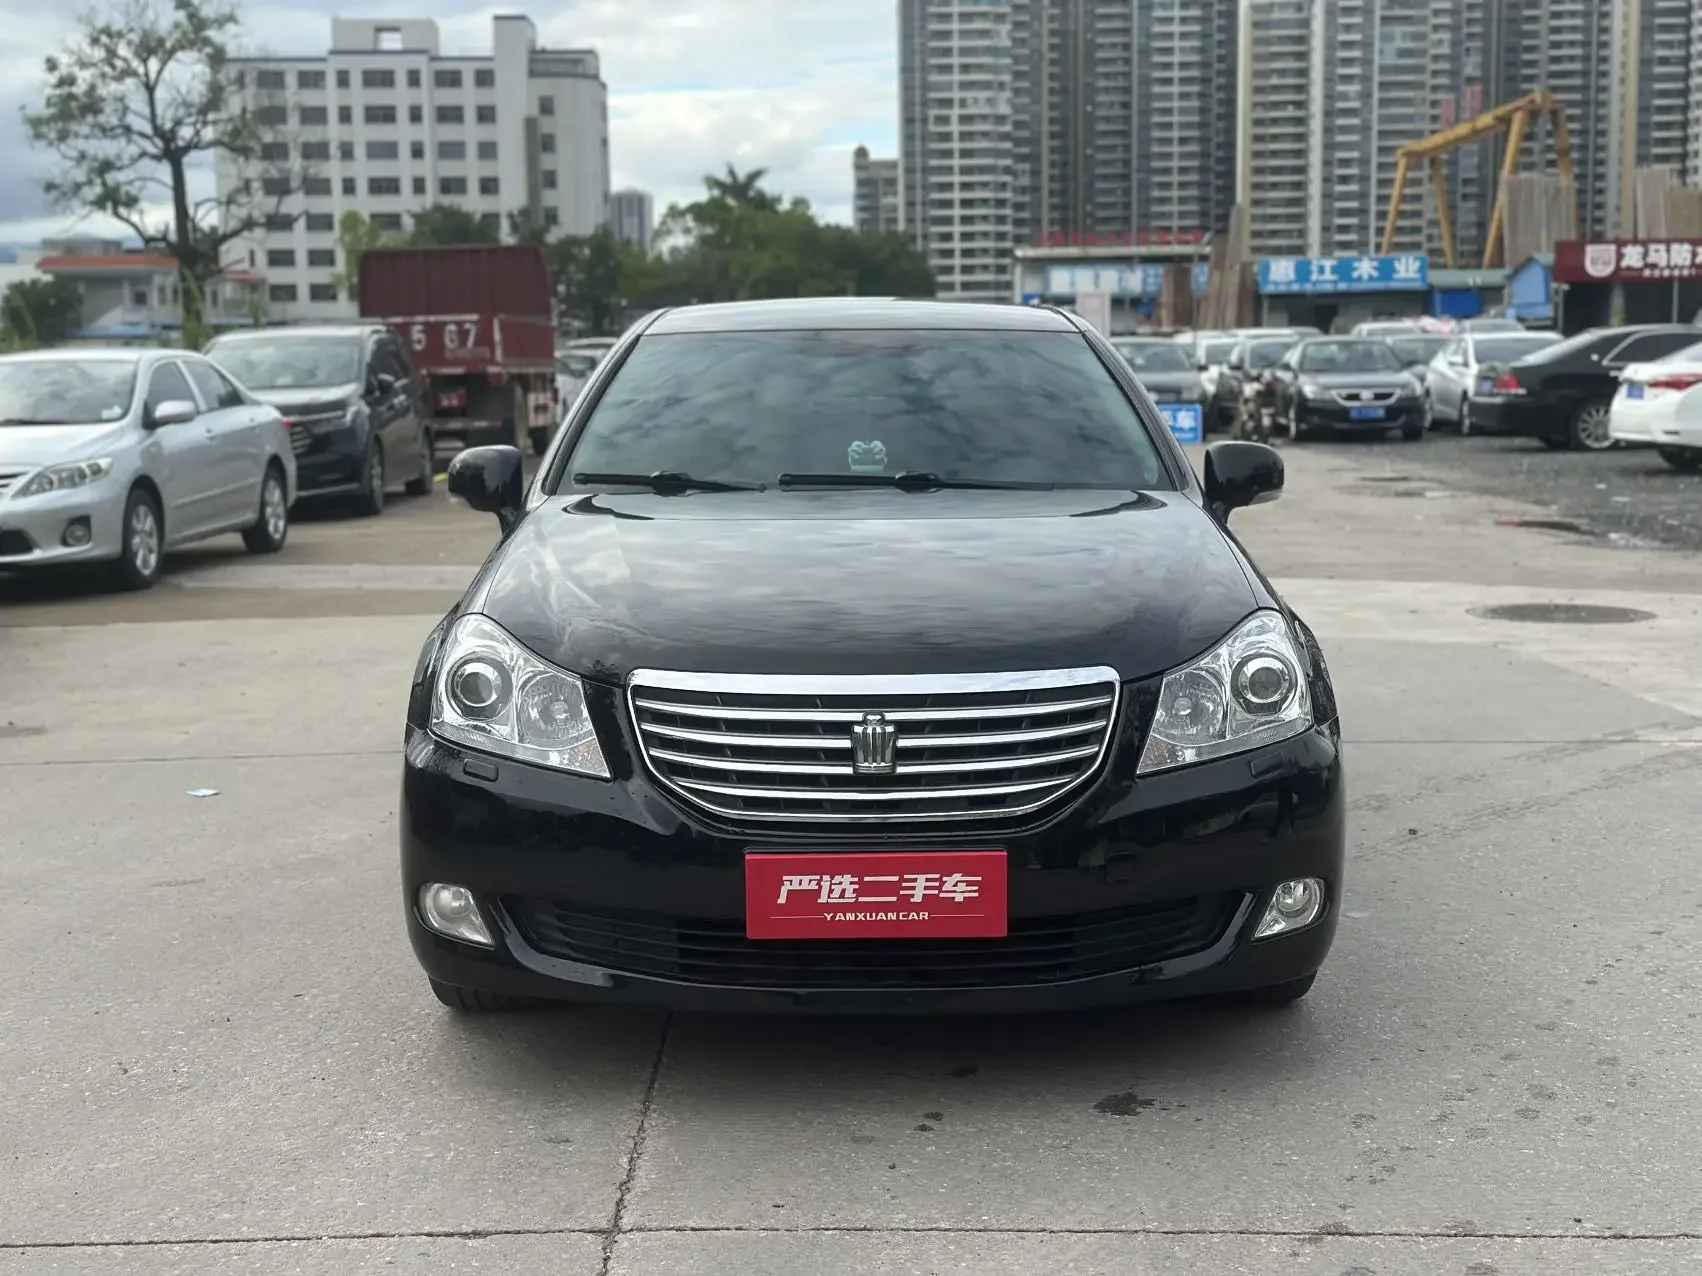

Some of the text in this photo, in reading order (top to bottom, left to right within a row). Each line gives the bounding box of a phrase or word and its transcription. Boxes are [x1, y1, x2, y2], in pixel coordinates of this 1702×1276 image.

[777, 873, 982, 903] 严选二手车
